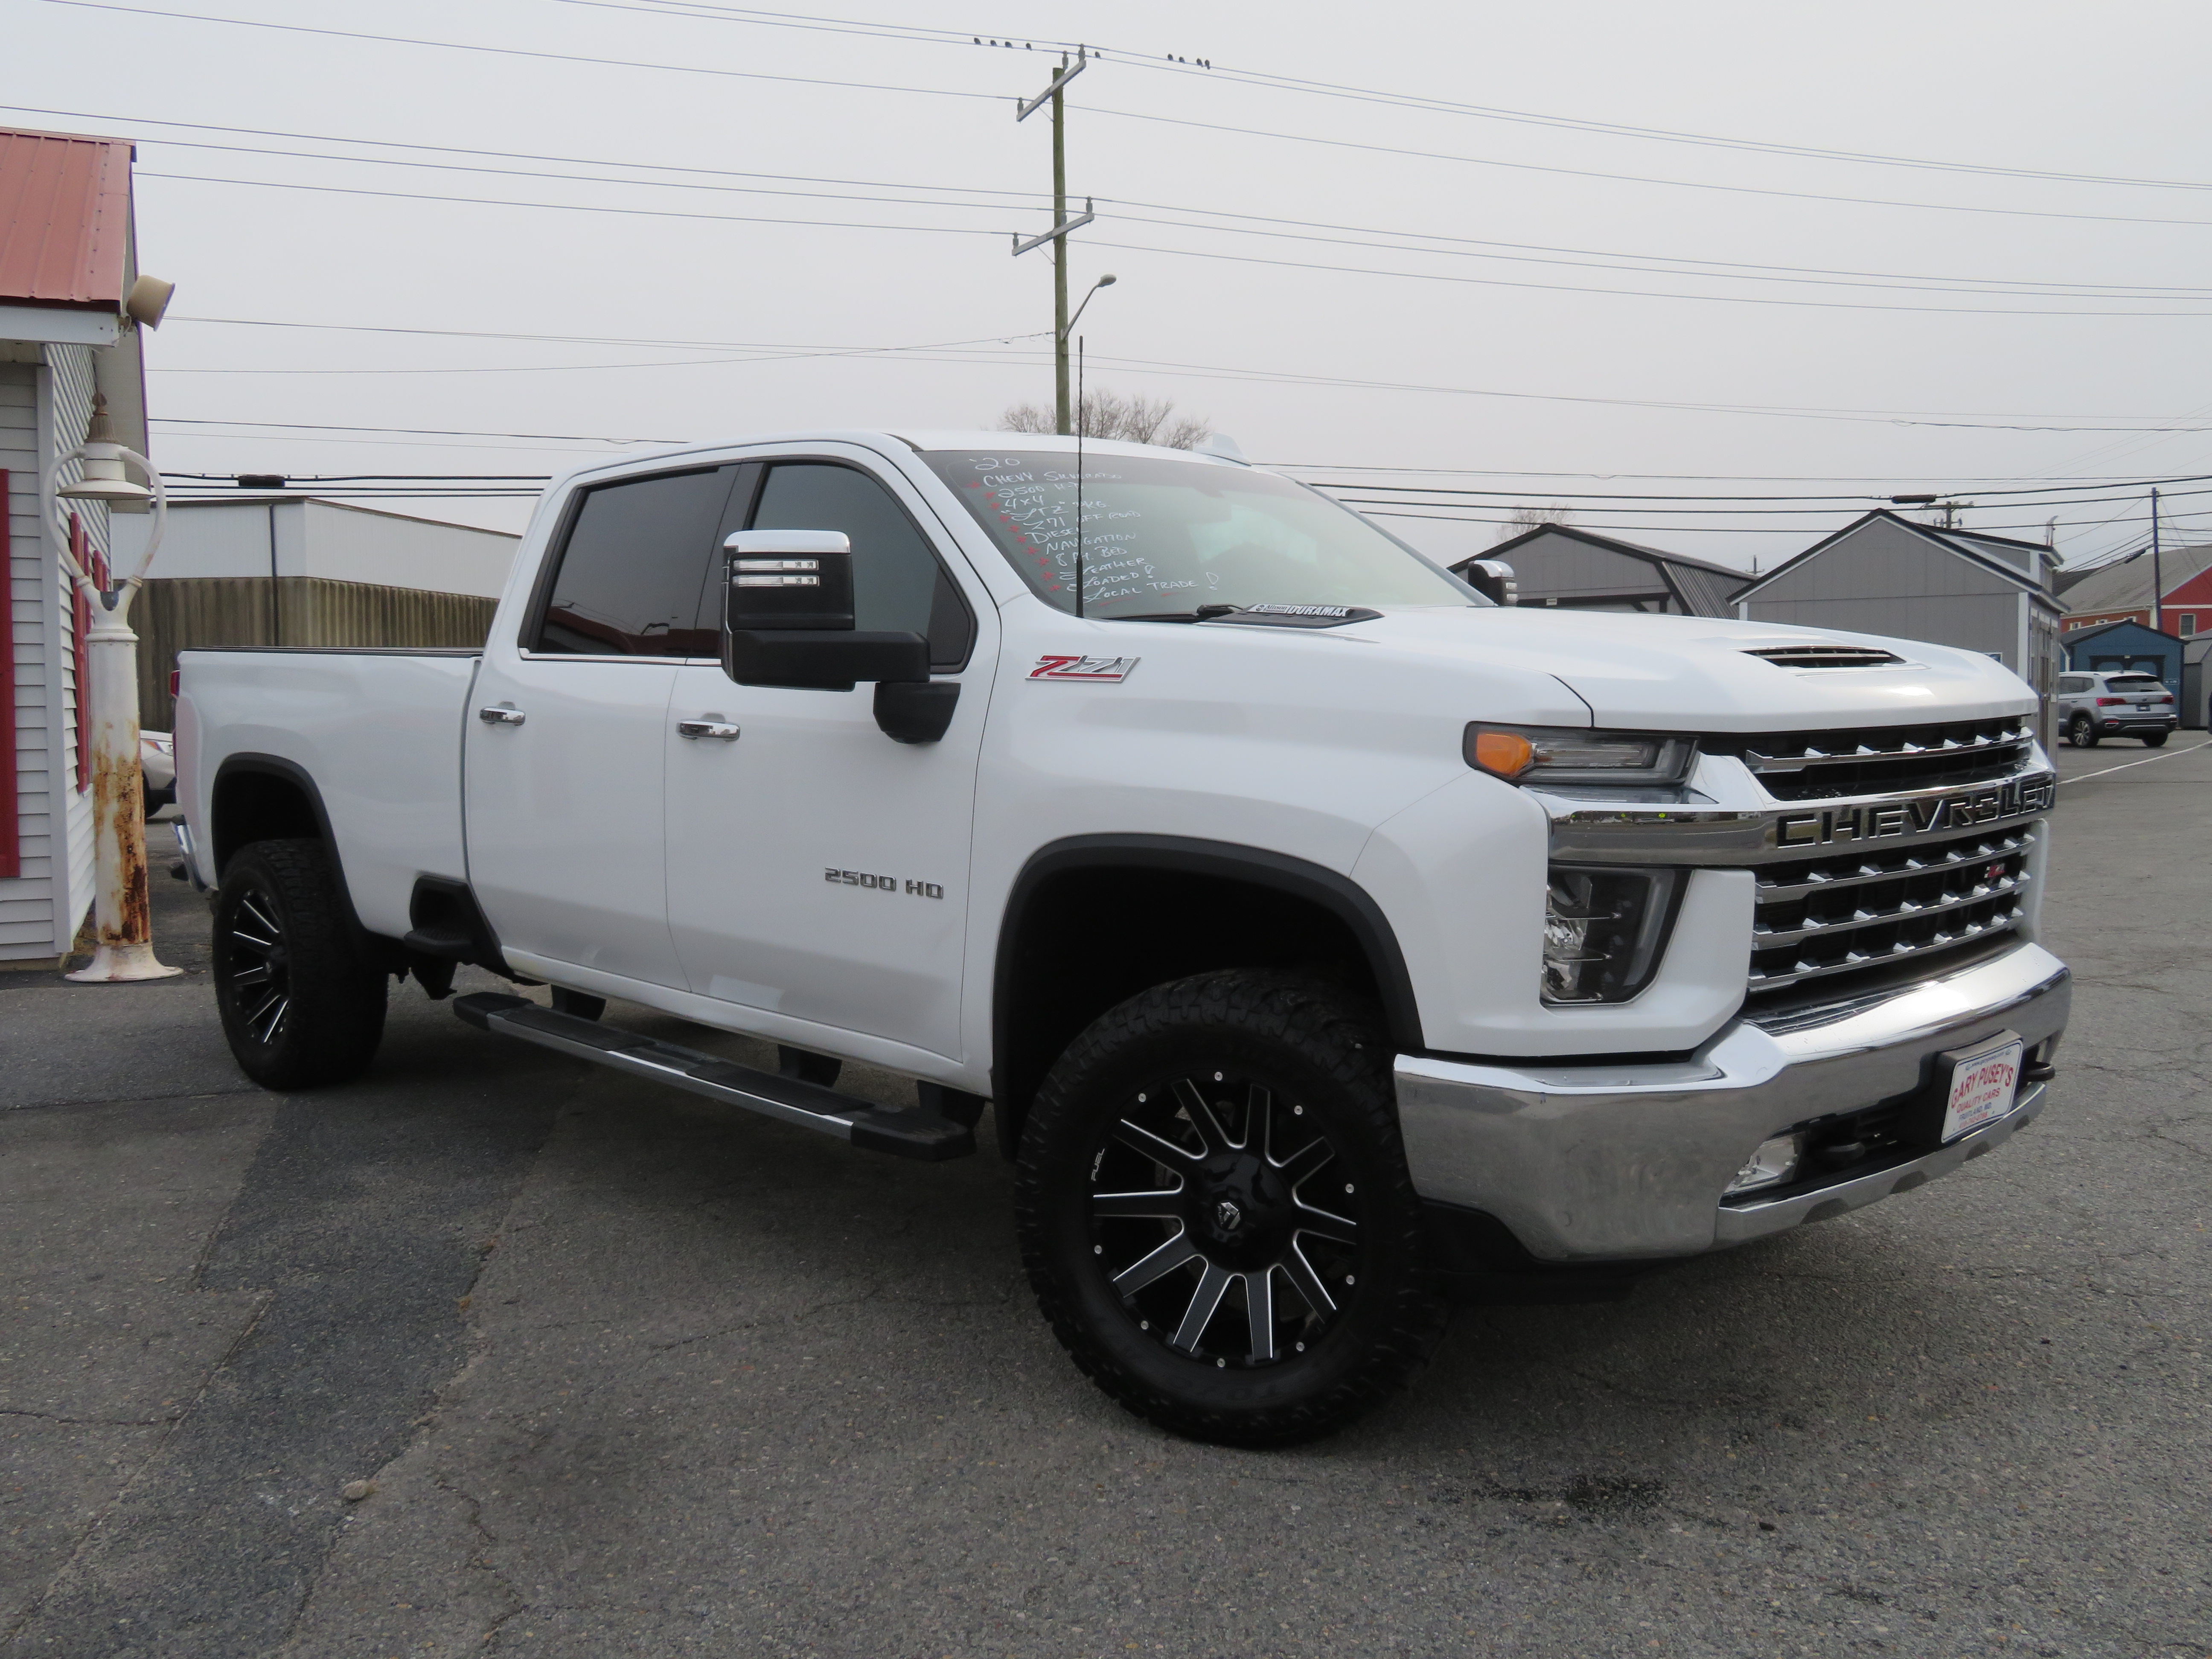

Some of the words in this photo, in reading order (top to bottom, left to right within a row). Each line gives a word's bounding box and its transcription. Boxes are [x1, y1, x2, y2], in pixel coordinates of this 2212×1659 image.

[983, 472, 1034, 487] CHEVY
[998, 485, 1045, 498] 2500
[1023, 516, 1066, 530] Z71
[1076, 514, 1103, 523] OFF
[1109, 510, 1141, 520] ROAD
[1025, 527, 1089, 544] DIESEL
[1055, 552, 1068, 566] 8
[1094, 546, 1127, 558] BED
[1059, 557, 1151, 580] LEATHER
[1083, 587, 1142, 604] LOCAL
[1289, 605, 1351, 617] DURAMAX
[1025, 654, 1141, 683] Z71
[1776, 779, 2054, 849] CHEVROLET
[824, 867, 896, 892] 2500
[905, 878, 944, 899] HD
[1951, 1070, 1979, 1109] GARY
[1977, 1063, 2014, 1088] PUSEY'S
[1956, 1095, 1982, 1114] QUALITY
[1982, 1087, 2001, 1102] CARS
[1091, 1148, 1105, 1181] FUEL
